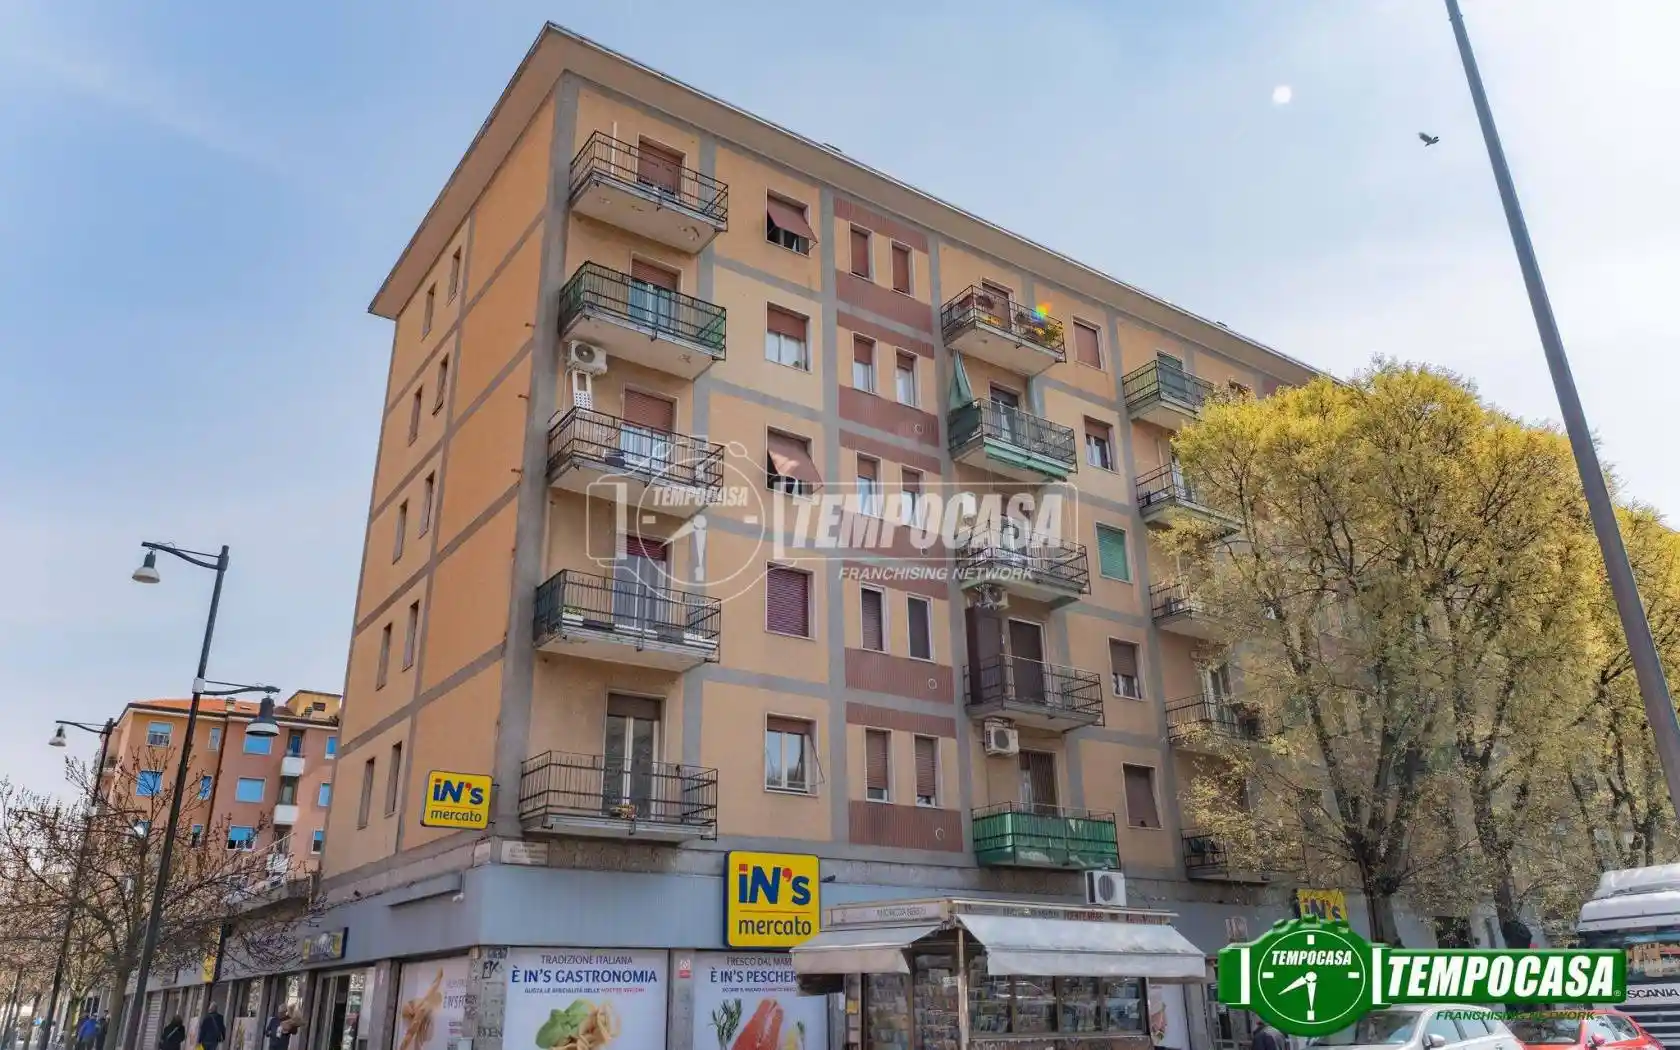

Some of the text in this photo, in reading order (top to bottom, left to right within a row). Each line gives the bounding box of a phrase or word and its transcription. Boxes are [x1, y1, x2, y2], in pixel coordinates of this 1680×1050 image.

[431, 810, 482, 822] mercato
[738, 916, 812, 936] mercato
[541, 955, 633, 964] TRADIZIONE ITALIANA
[726, 956, 756, 966] FRESCO
[511, 965, 520, 982] È
[524, 968, 551, 982] IN'S
[555, 969, 657, 983] GASTRONOMIA
[711, 967, 717, 982] È
[721, 971, 744, 982] IN'S
[1628, 988, 1680, 998] SCANIA
